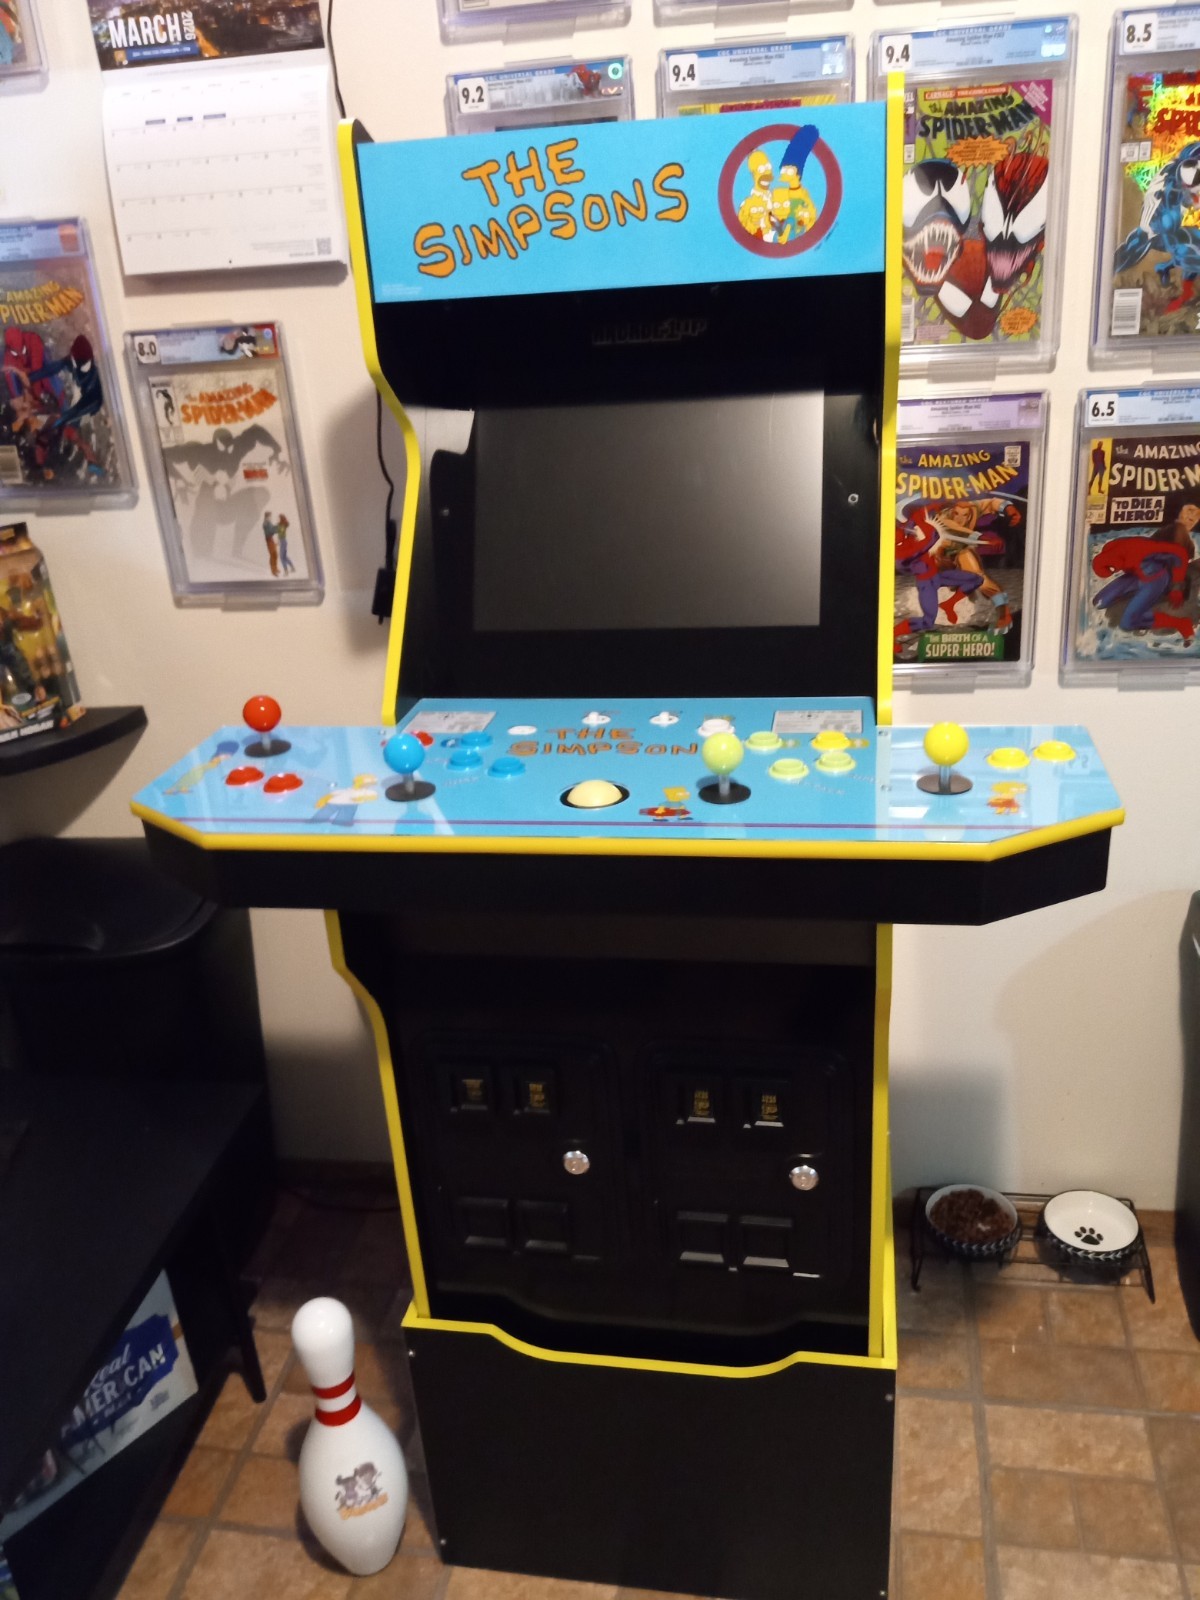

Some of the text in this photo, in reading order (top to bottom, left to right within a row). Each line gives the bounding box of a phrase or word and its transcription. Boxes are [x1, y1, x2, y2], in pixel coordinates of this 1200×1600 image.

[107, 12, 182, 48] MARCH
[181, 11, 197, 41] 2026
[1126, 23, 1153, 43] 8.5
[886, 44, 910, 64] 9.4
[672, 64, 696, 82] 9.4
[461, 85, 485, 105] 9.2
[944, 95, 1015, 116] AMAZING
[919, 100, 1039, 140] SPIDER-MAN
[461, 137, 585, 207] THE
[413, 162, 689, 278] SIMPSONS
[0, 287, 85, 325] PIDER-MAN
[138, 341, 157, 357] 8.0
[1091, 401, 1115, 417] 6.5
[918, 450, 991, 468] AMAZING
[896, 464, 1018, 500] SPIDER-MAN
[1131, 498, 1153, 510] DIE
[1154, 498, 1164, 510] A
[941, 633, 970, 643] BIRTH
[925, 642, 996, 657] SUPER HERO!
[547, 727, 636, 740] THE
[508, 740, 698, 757] SIMPSON
